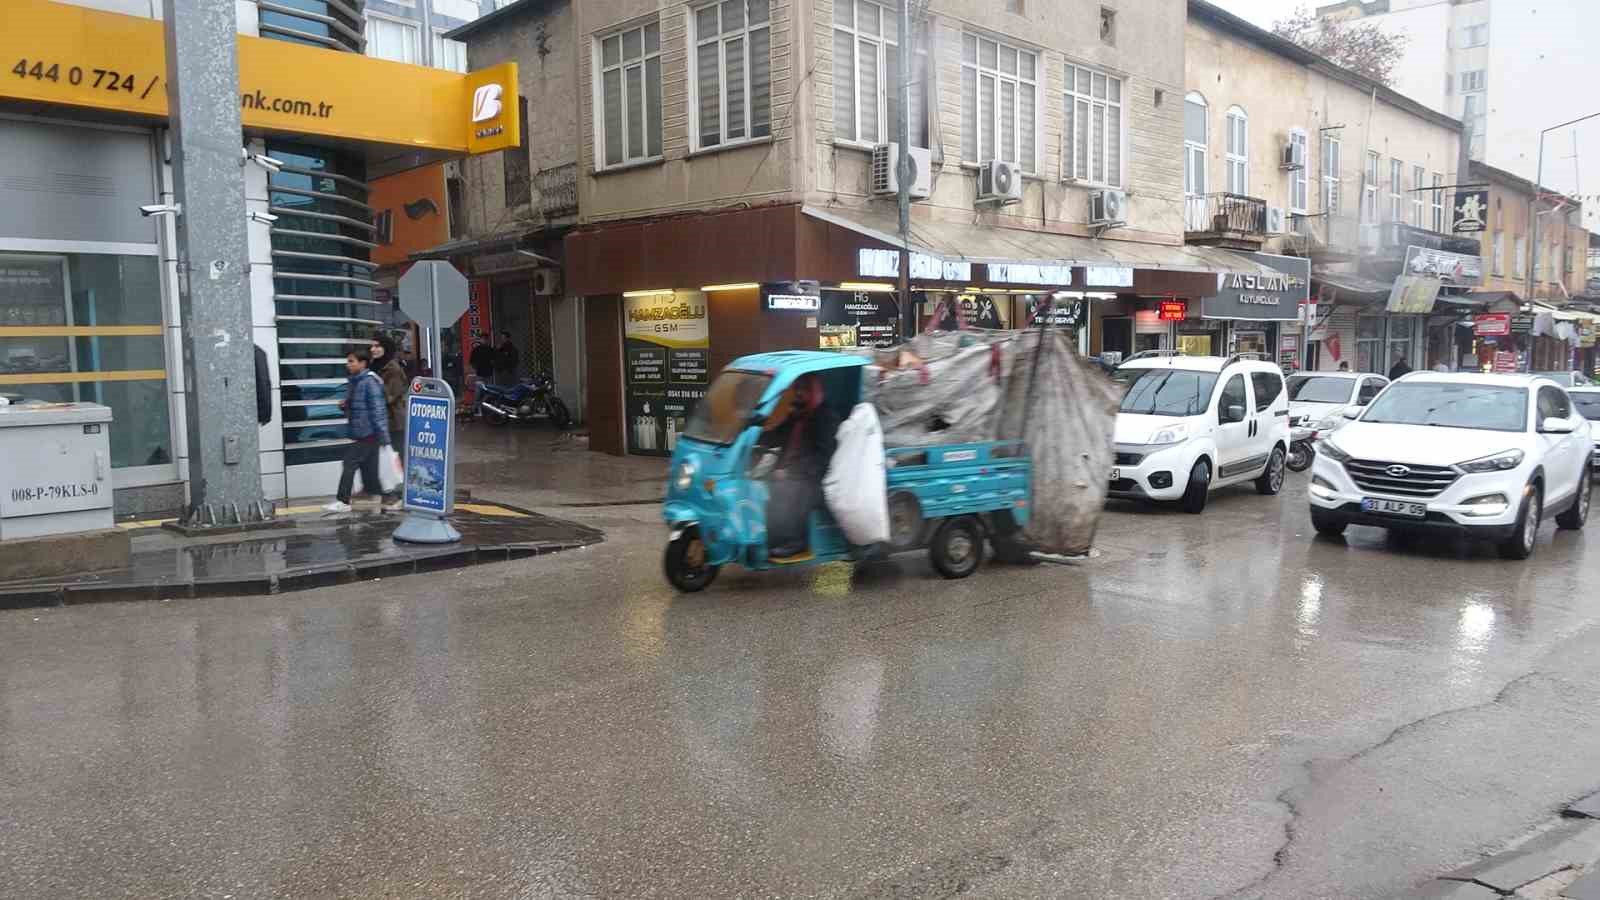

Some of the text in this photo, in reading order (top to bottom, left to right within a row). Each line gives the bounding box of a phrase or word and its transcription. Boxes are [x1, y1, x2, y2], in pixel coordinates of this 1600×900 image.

[12, 58, 59, 82] 444
[69, 66, 82, 86] 0
[93, 69, 134, 93] 724
[240, 89, 333, 118] nk.com.tr
[1231, 272, 1289, 292] ASLAN
[654, 323, 678, 333] GSM
[411, 403, 447, 420] OTOPARK
[418, 431, 436, 444] OTO
[410, 444, 444, 461] YIKAMA
[11, 482, 98, 502] 008-P-79KLS-0
[1383, 500, 1405, 513] ALP
